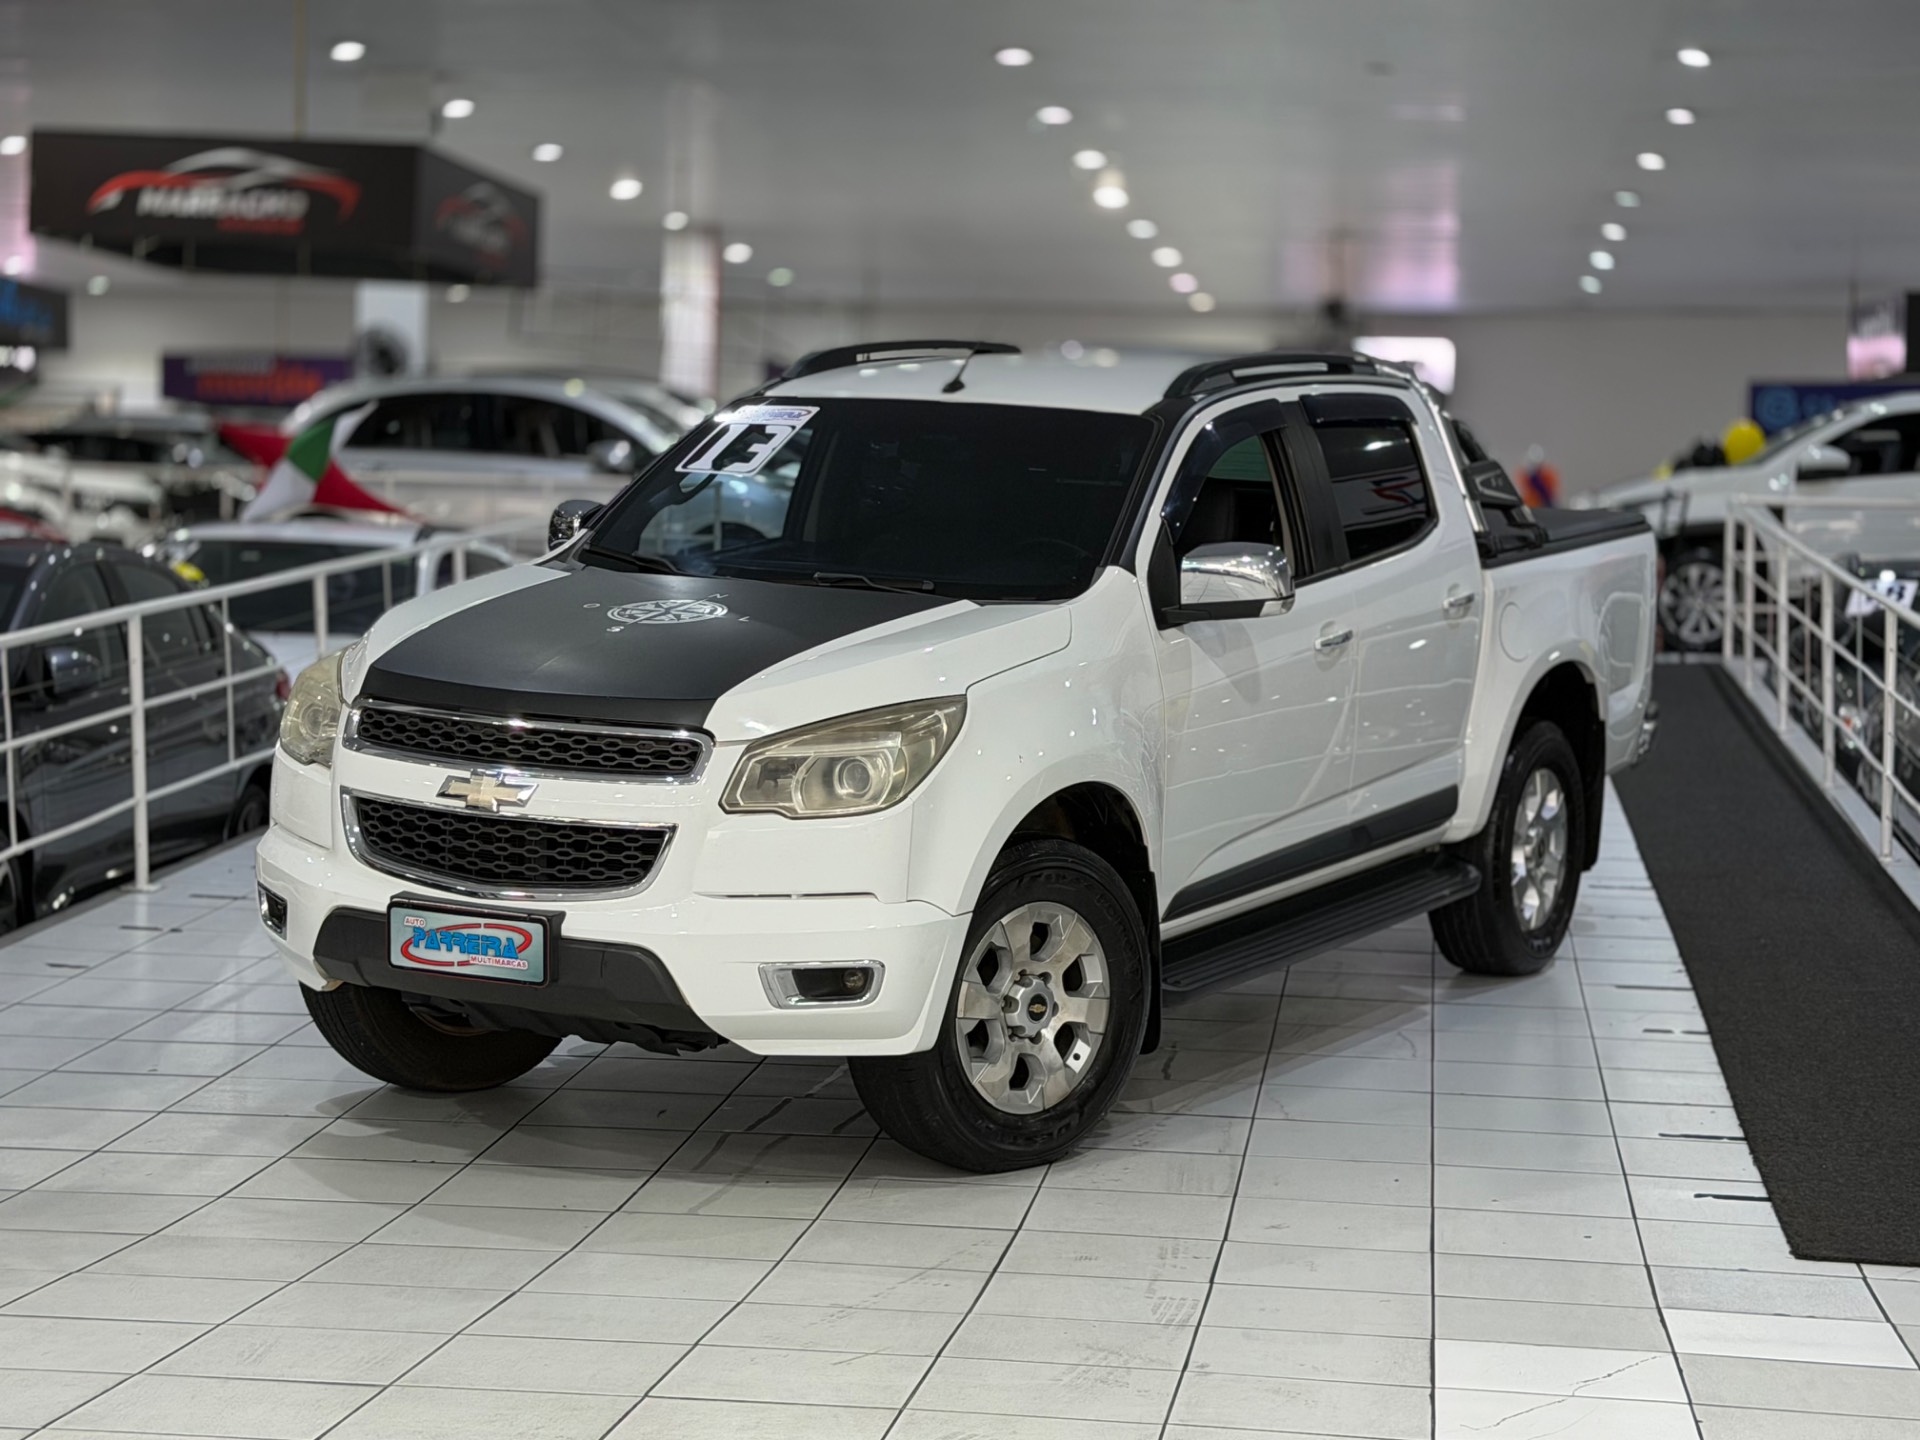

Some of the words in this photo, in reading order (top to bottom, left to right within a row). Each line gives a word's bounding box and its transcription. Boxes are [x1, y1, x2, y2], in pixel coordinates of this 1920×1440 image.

[405, 917, 425, 926] AUTO
[412, 927, 519, 959] PARREIRA
[470, 955, 527, 969] MULTIMARCAS
